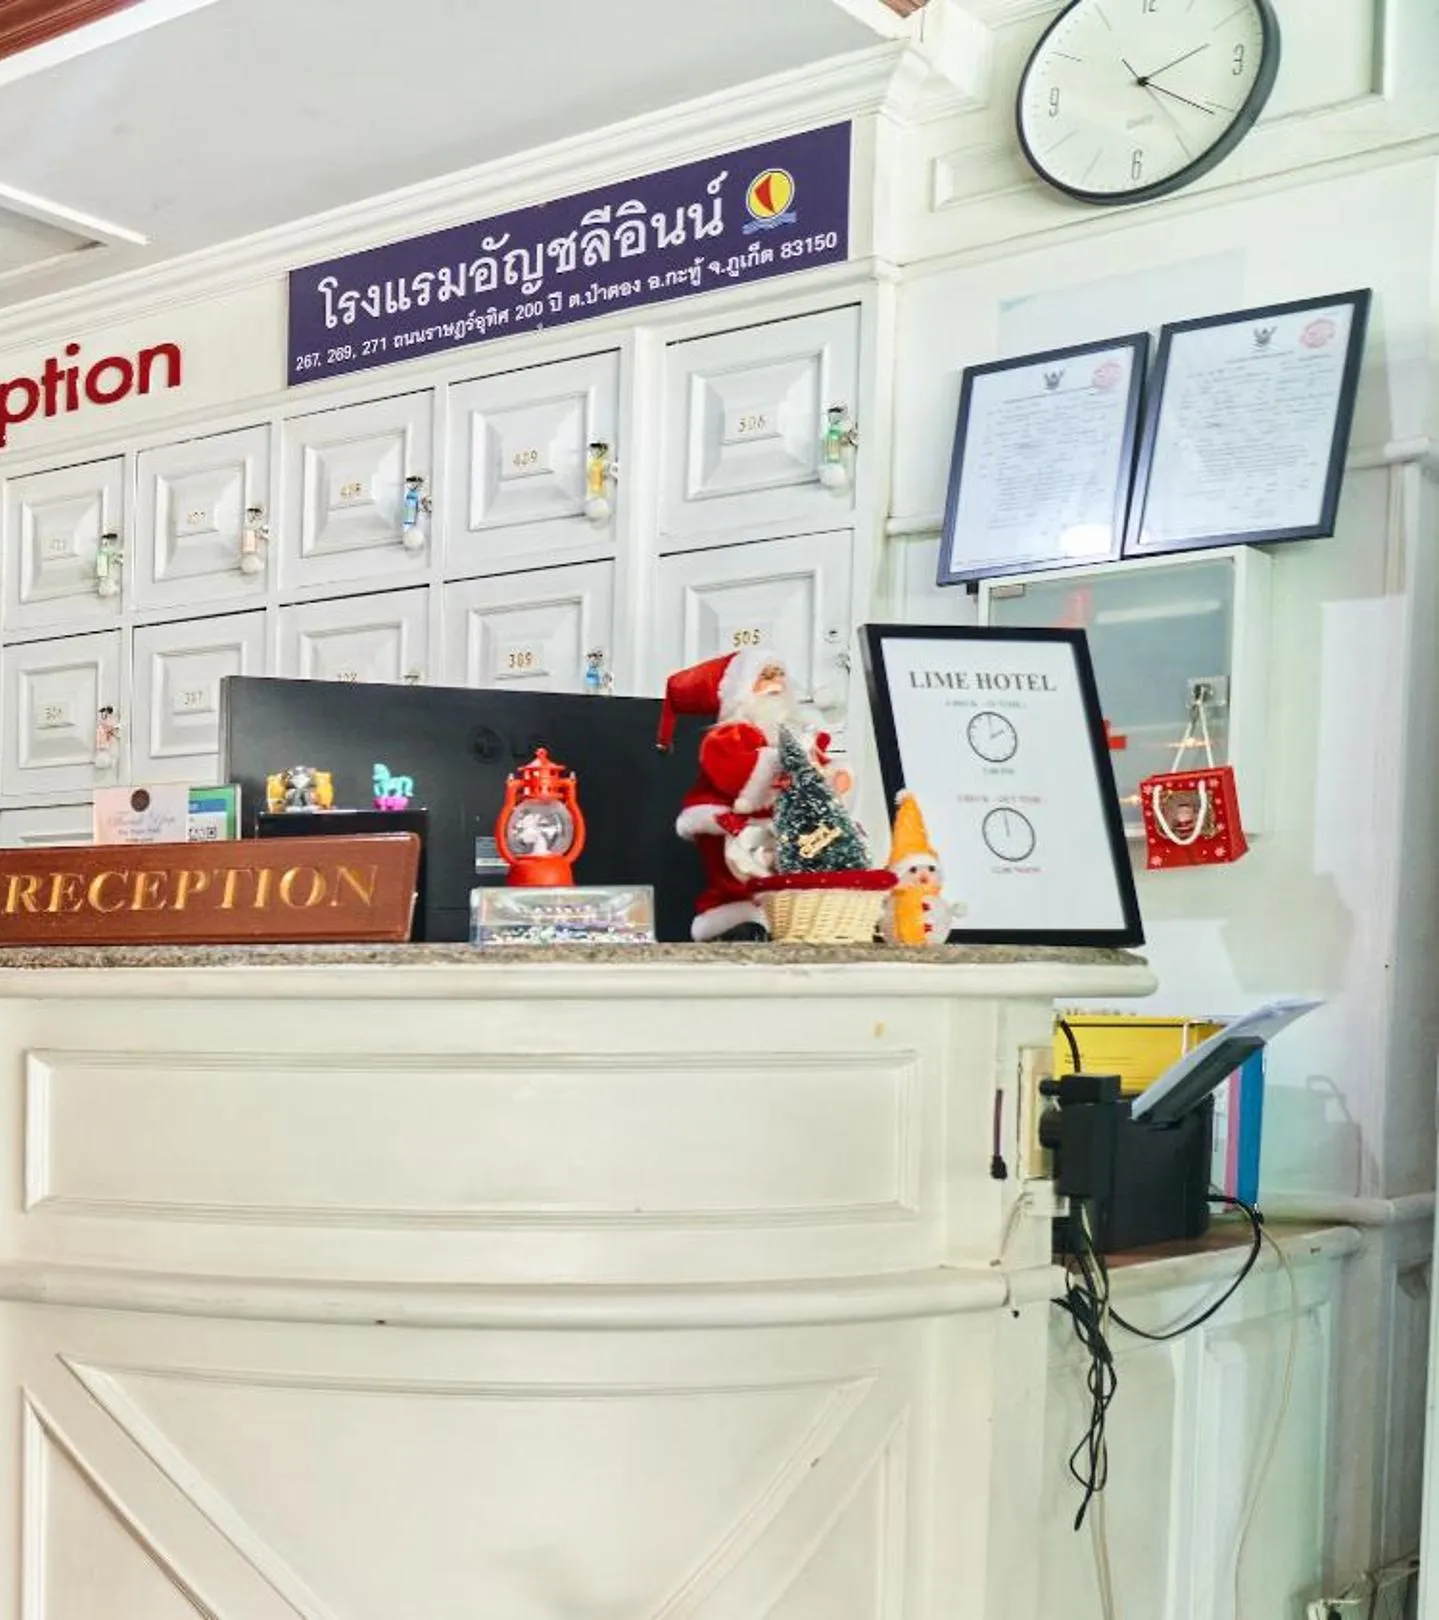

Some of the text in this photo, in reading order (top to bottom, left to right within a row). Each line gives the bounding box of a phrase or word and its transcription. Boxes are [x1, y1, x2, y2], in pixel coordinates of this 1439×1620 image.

[1232, 44, 1244, 75] 3
[1048, 87, 1060, 117] 9
[1131, 149, 1142, 180] 6
[316, 171, 730, 330] โรงแรมอัญชลีอินน์
[361, 337, 387, 357] 271
[515, 300, 544, 321] 200
[548, 291, 563, 313] ปี
[780, 231, 838, 259] 83150
[732, 628, 762, 647] 505
[909, 670, 1057, 692] LIME HOTEL
[2, 863, 379, 915] RECEPTION
